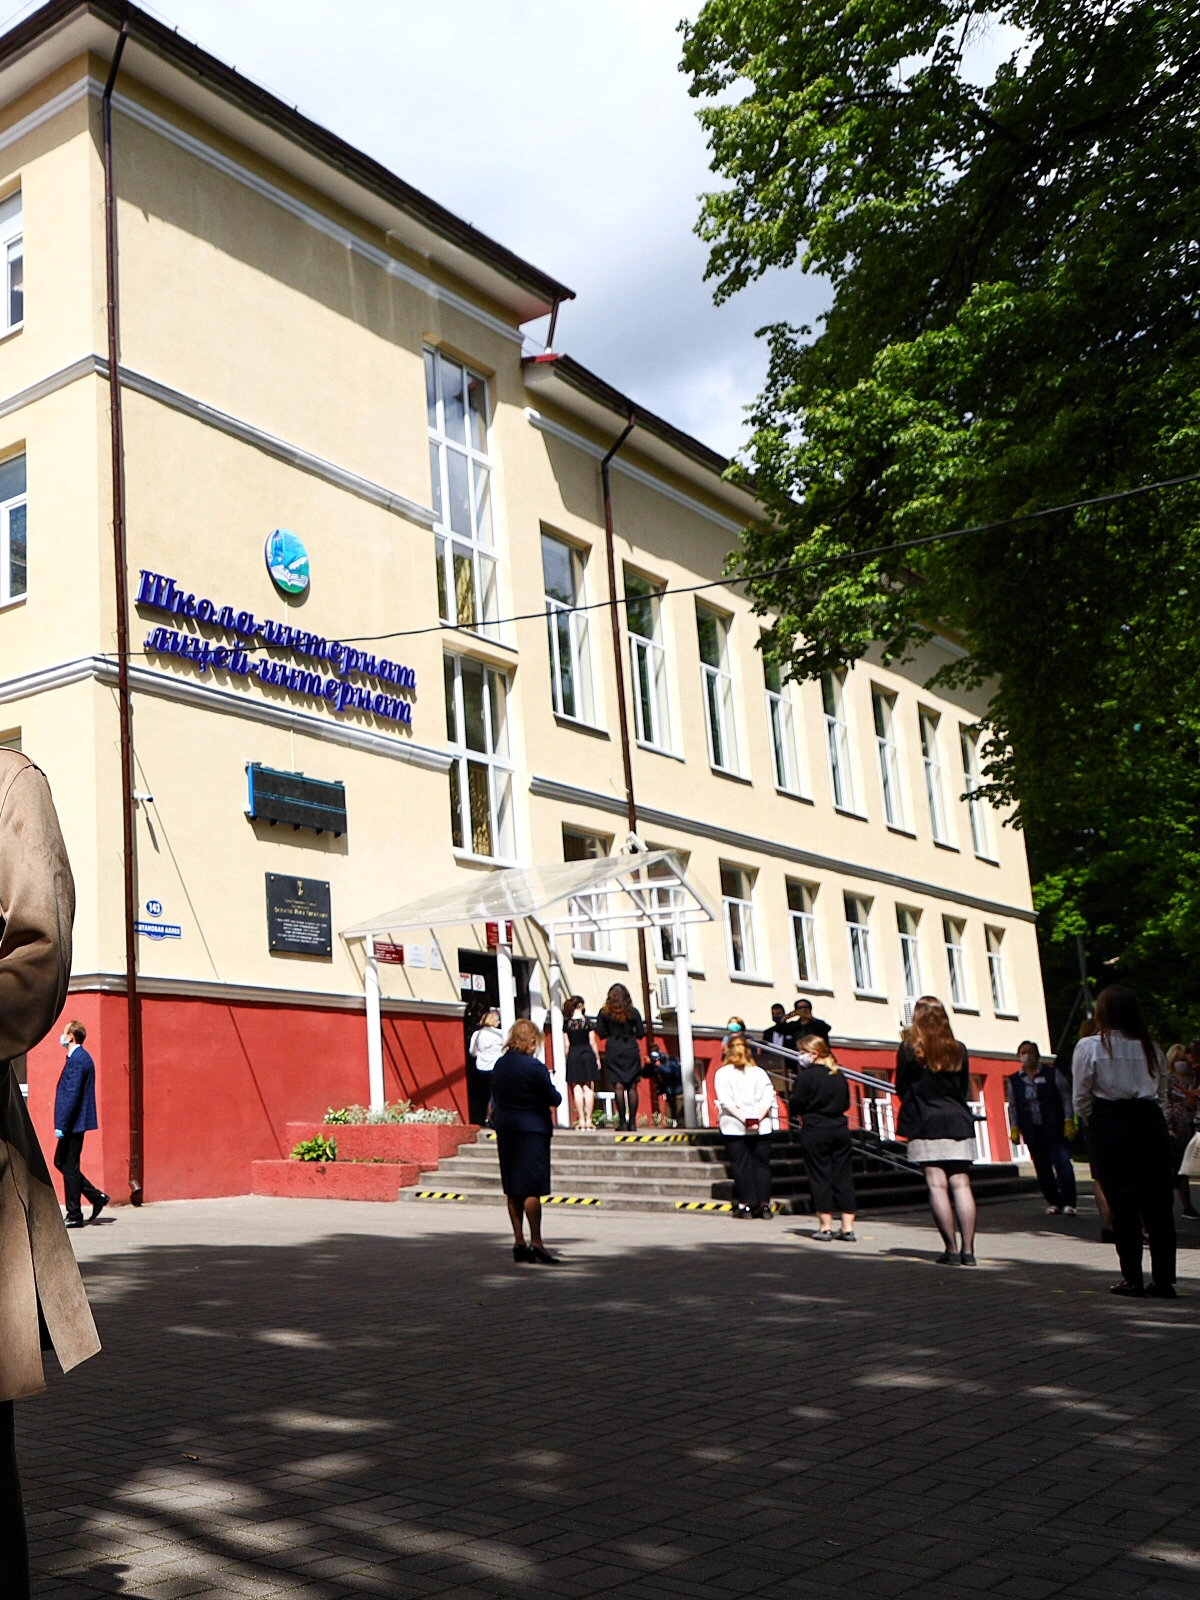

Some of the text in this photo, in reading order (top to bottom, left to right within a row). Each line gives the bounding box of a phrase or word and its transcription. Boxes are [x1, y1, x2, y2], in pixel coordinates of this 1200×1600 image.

[135, 569, 416, 689] Школа-интернат
[143, 627, 413, 724] лицей-интернат
[134, 923, 164, 933] АШТАНОВАЯ
[149, 902, 161, 914] 143
